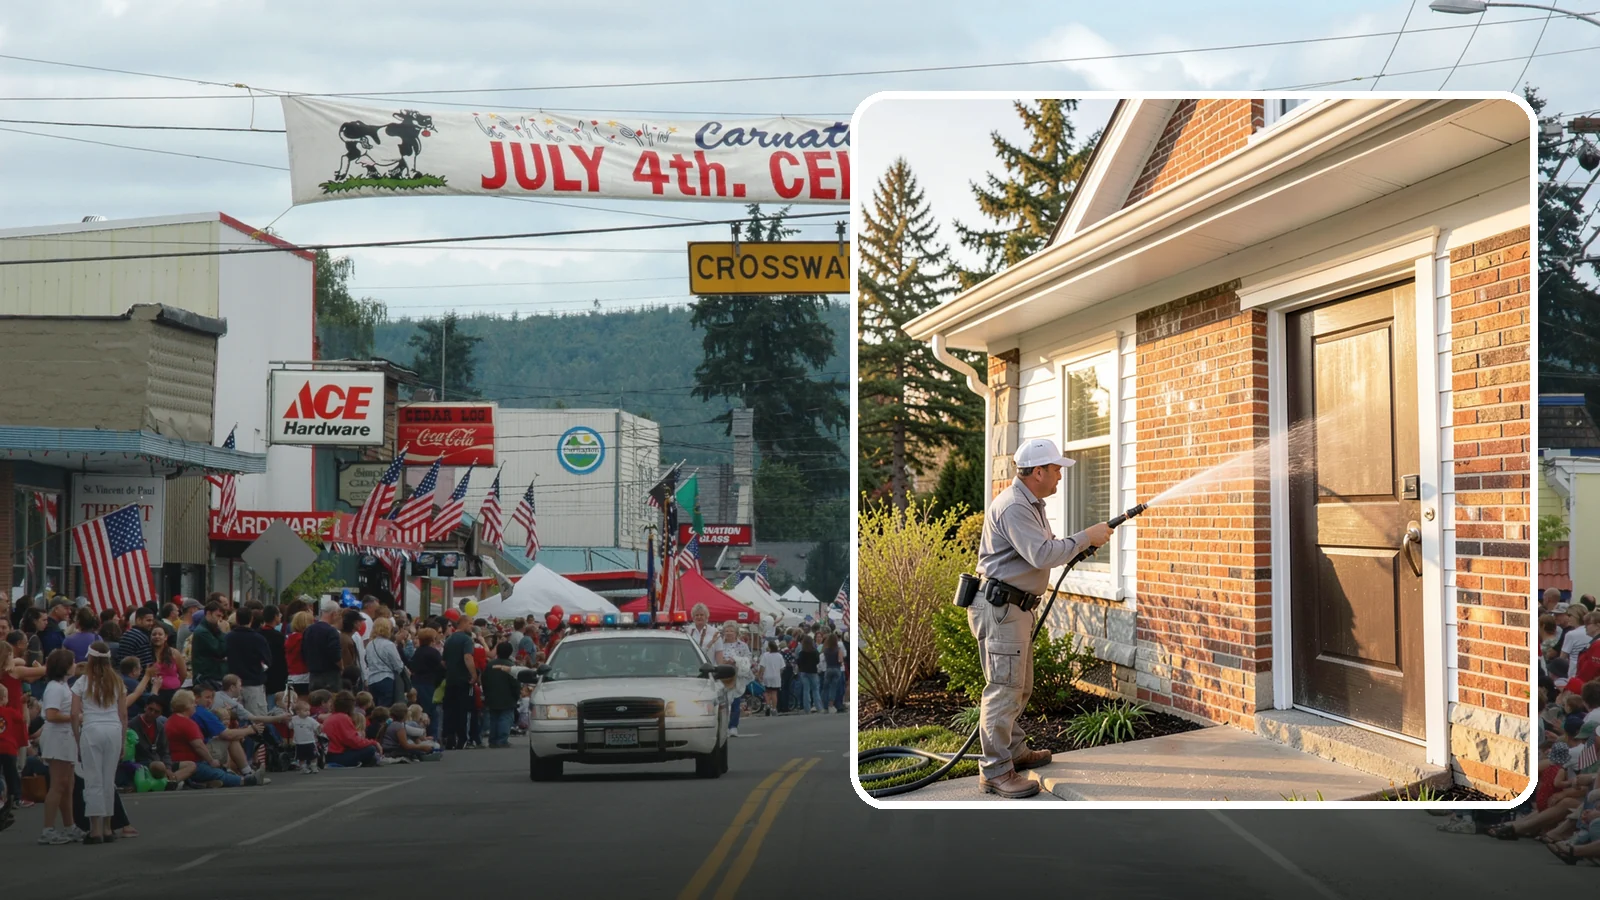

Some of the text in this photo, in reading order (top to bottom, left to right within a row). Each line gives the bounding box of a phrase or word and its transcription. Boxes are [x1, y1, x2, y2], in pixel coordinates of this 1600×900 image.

[481, 141, 604, 192] JULY
[632, 150, 746, 198] 4th.
[697, 254, 850, 280] CROSSWA
[283, 380, 373, 420] ACE
[406, 409, 485, 421] CEDAR LOG
[284, 421, 370, 436] Hardware
[354, 467, 384, 479] Simpl
[96, 485, 124, 494] Vincent
[126, 486, 136, 495] de
[137, 486, 155, 495] Paul
[688, 526, 741, 535] CRNATION
[699, 535, 730, 543] GLASS
